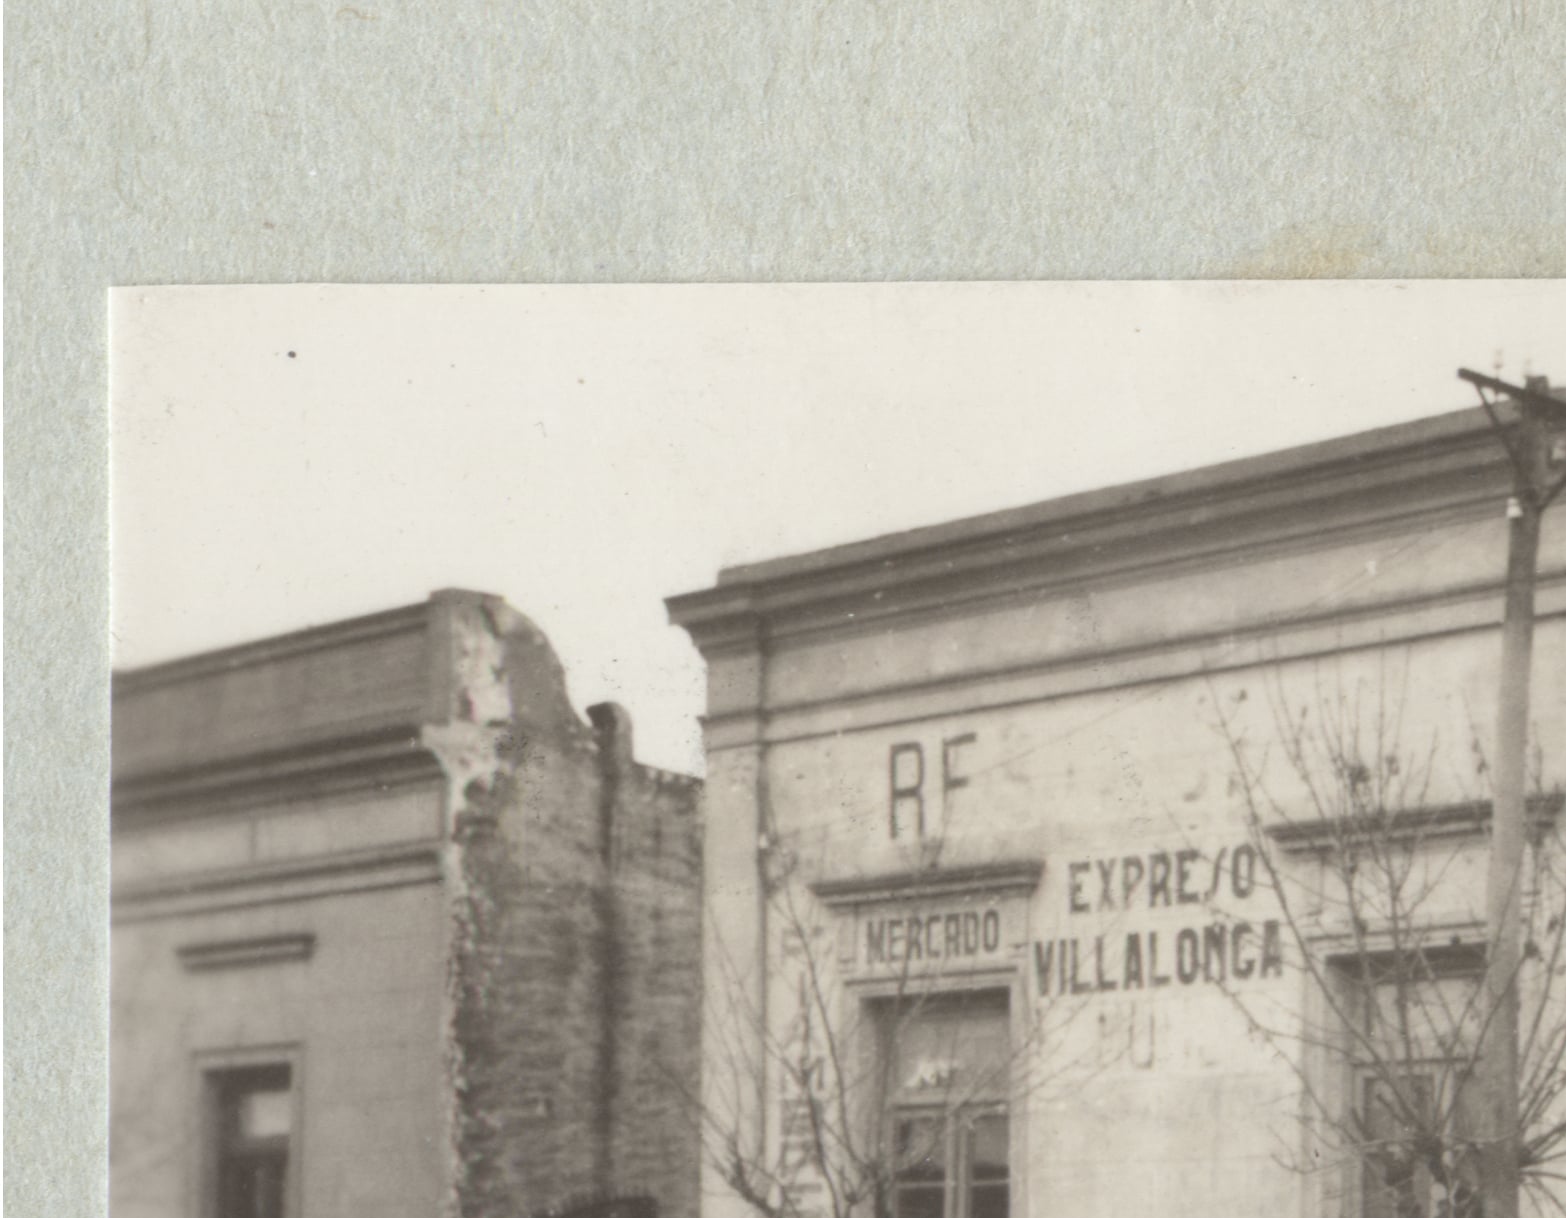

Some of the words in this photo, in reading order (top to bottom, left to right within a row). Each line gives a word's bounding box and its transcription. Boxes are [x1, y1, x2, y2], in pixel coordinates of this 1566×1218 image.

[1068, 843, 1257, 914] EXPRESO
[867, 908, 999, 964] MERCADO
[1033, 920, 1283, 996] VILLALONGA
